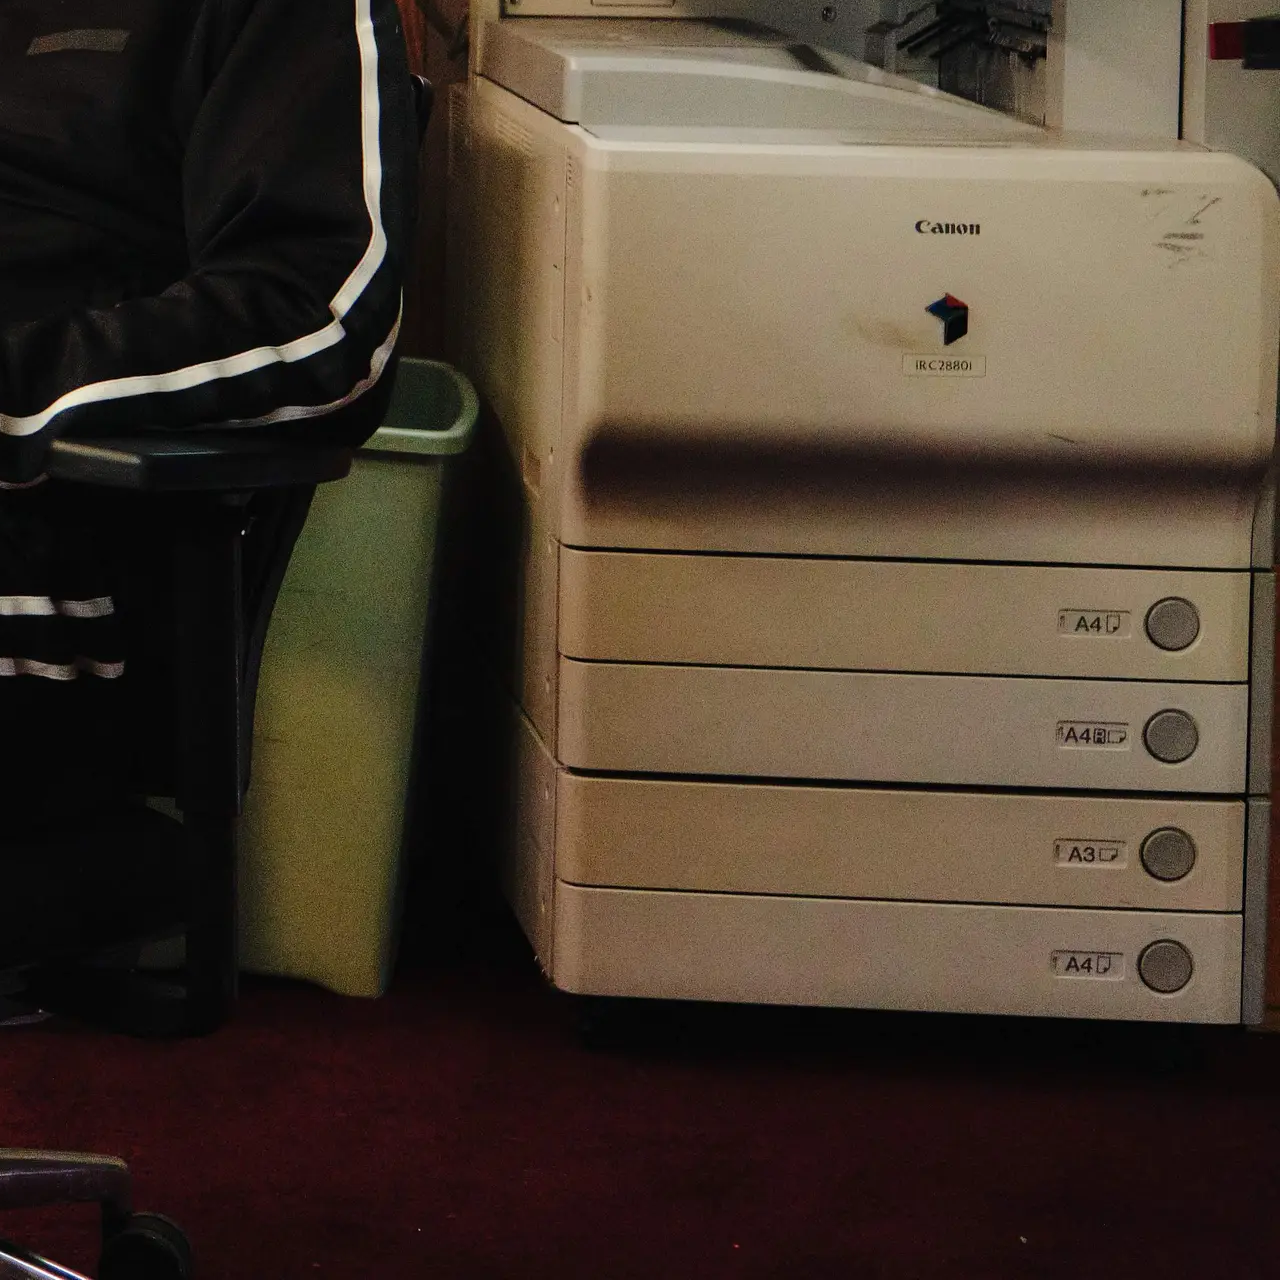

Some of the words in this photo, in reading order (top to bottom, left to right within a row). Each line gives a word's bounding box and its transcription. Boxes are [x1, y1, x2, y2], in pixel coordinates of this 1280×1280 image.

[914, 219, 981, 235] Canon
[1074, 615, 1102, 632] A4
[1067, 846, 1095, 863] A3
[1065, 956, 1093, 973] A4
